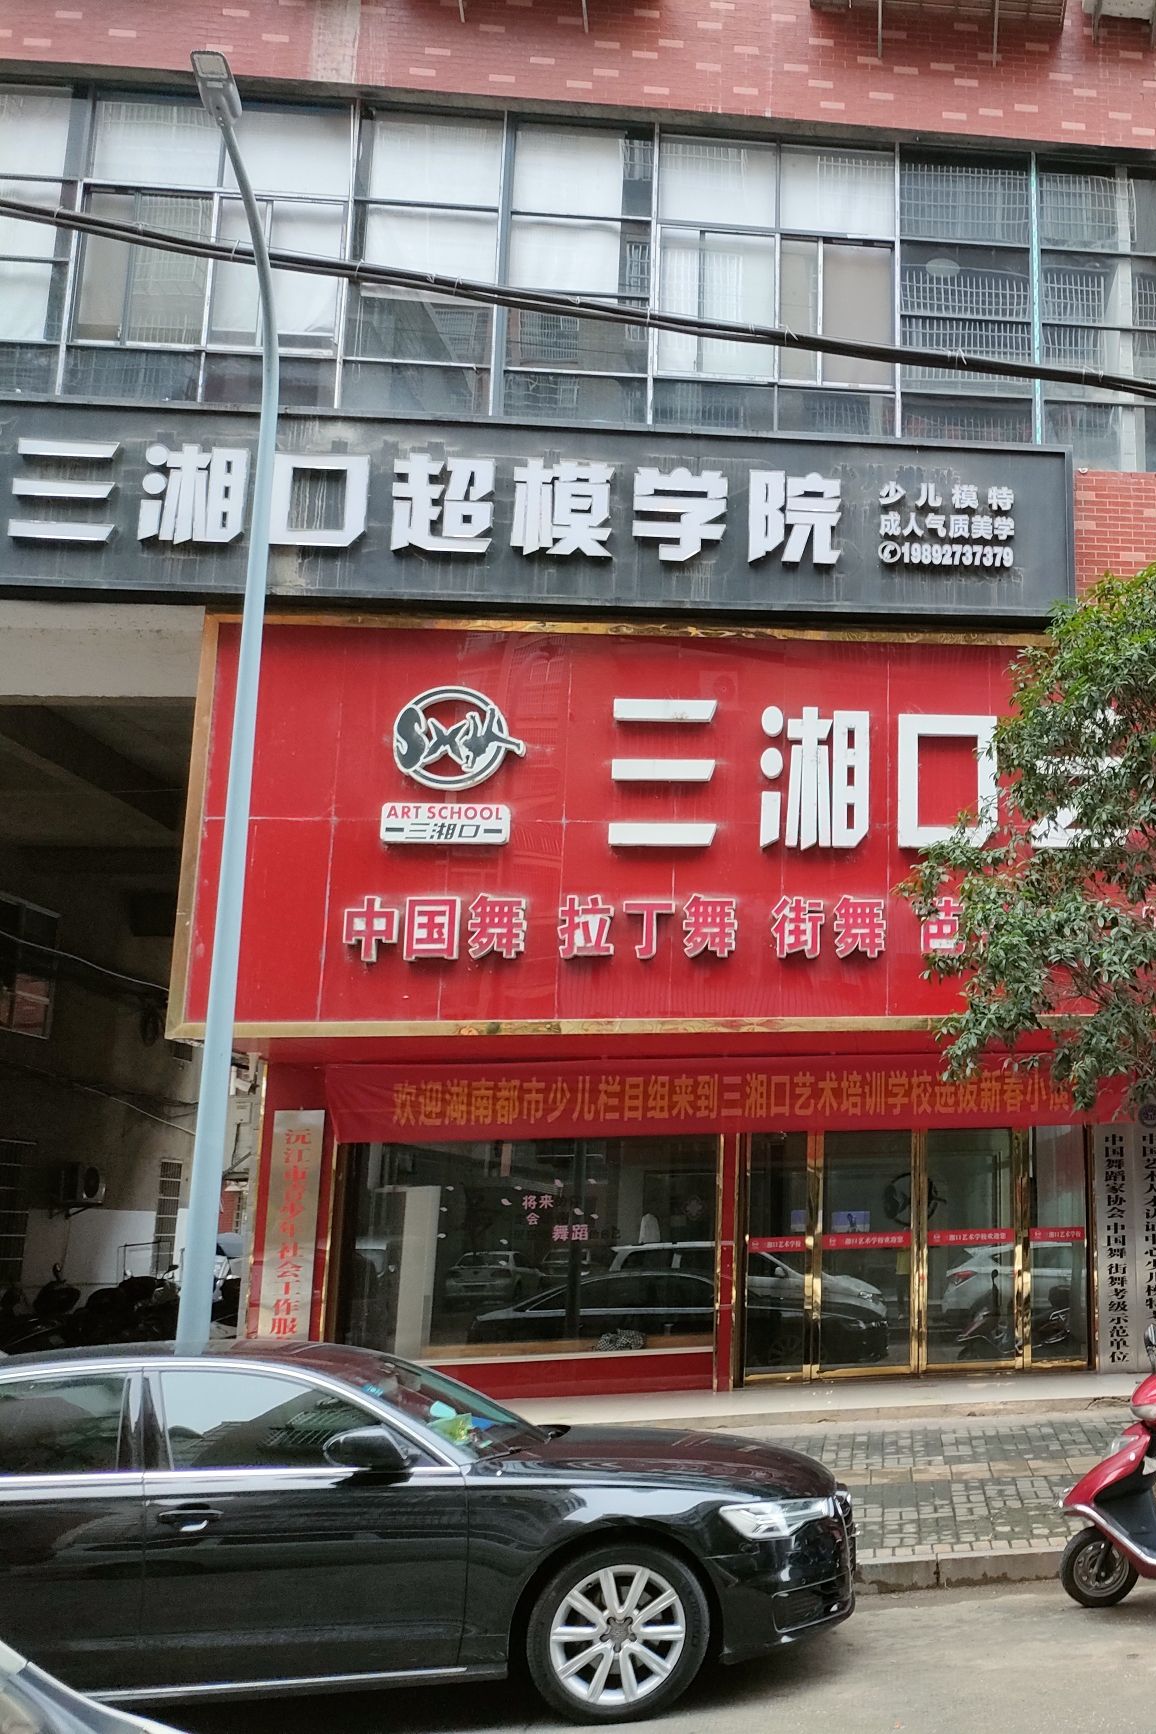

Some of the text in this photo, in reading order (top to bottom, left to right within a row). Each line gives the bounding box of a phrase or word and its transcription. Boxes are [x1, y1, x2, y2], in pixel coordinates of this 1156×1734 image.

[8, 438, 842, 564] 三湘口超模学院
[879, 481, 1015, 512] 少儿模特
[879, 511, 1015, 541] 成人气质美学
[901, 542, 1014, 568] 19892737379
[386, 806, 502, 821] ART SCHOOL
[405, 822, 481, 840] 三湘口
[342, 893, 528, 962] 中国舞
[557, 894, 738, 960] 拉丁舞
[771, 895, 887, 960] 街舞
[392, 1068, 1080, 1127] 欢迎湖南都市少儿栏目组来到三湘口艺术培训学校选拔新春小
[522, 1194, 554, 1210] 将来
[526, 1212, 540, 1225] 会
[269, 1128, 313, 1340] 沅江市青少年社会工作服
[552, 1224, 589, 1242] 舞蹈
